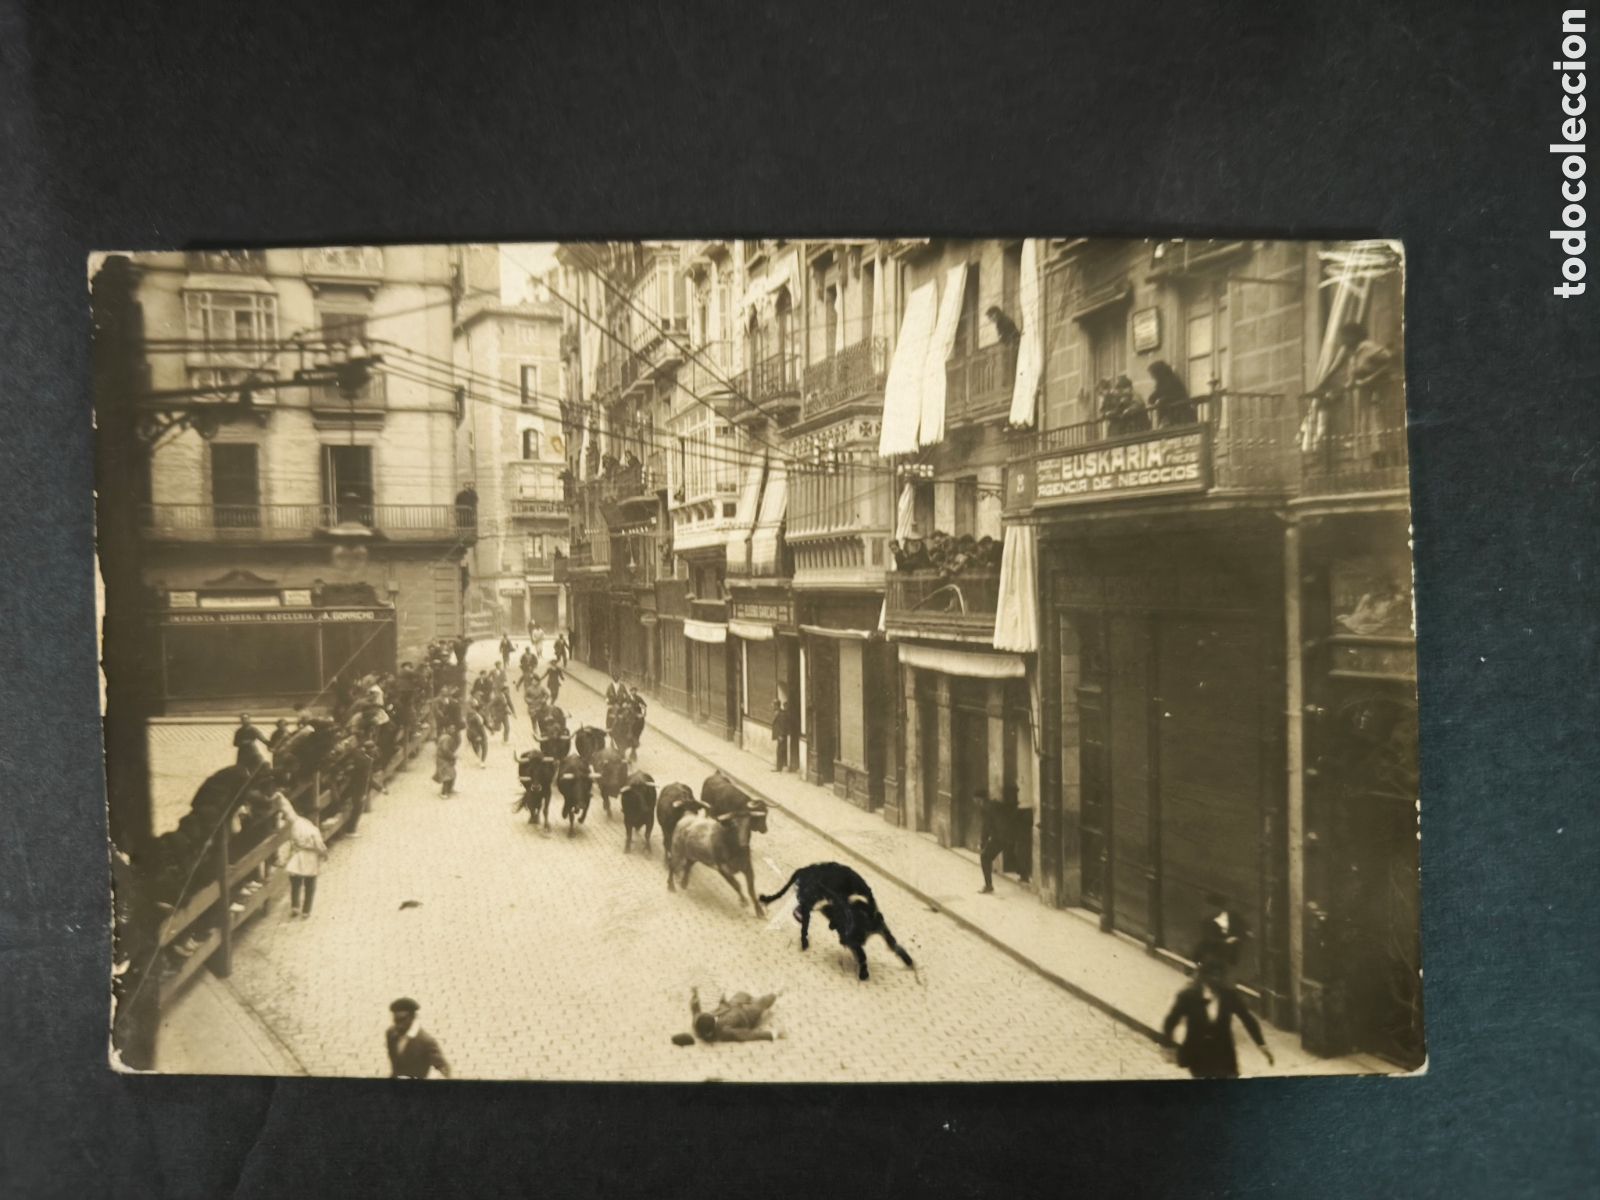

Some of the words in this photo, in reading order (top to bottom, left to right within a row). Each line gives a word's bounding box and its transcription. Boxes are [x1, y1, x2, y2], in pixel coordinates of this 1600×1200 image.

[1062, 440, 1163, 480] EUSKARIA
[1037, 478, 1088, 498] AGENCIA
[1093, 474, 1112, 491] DE
[1118, 463, 1199, 487] NEGOCIOS
